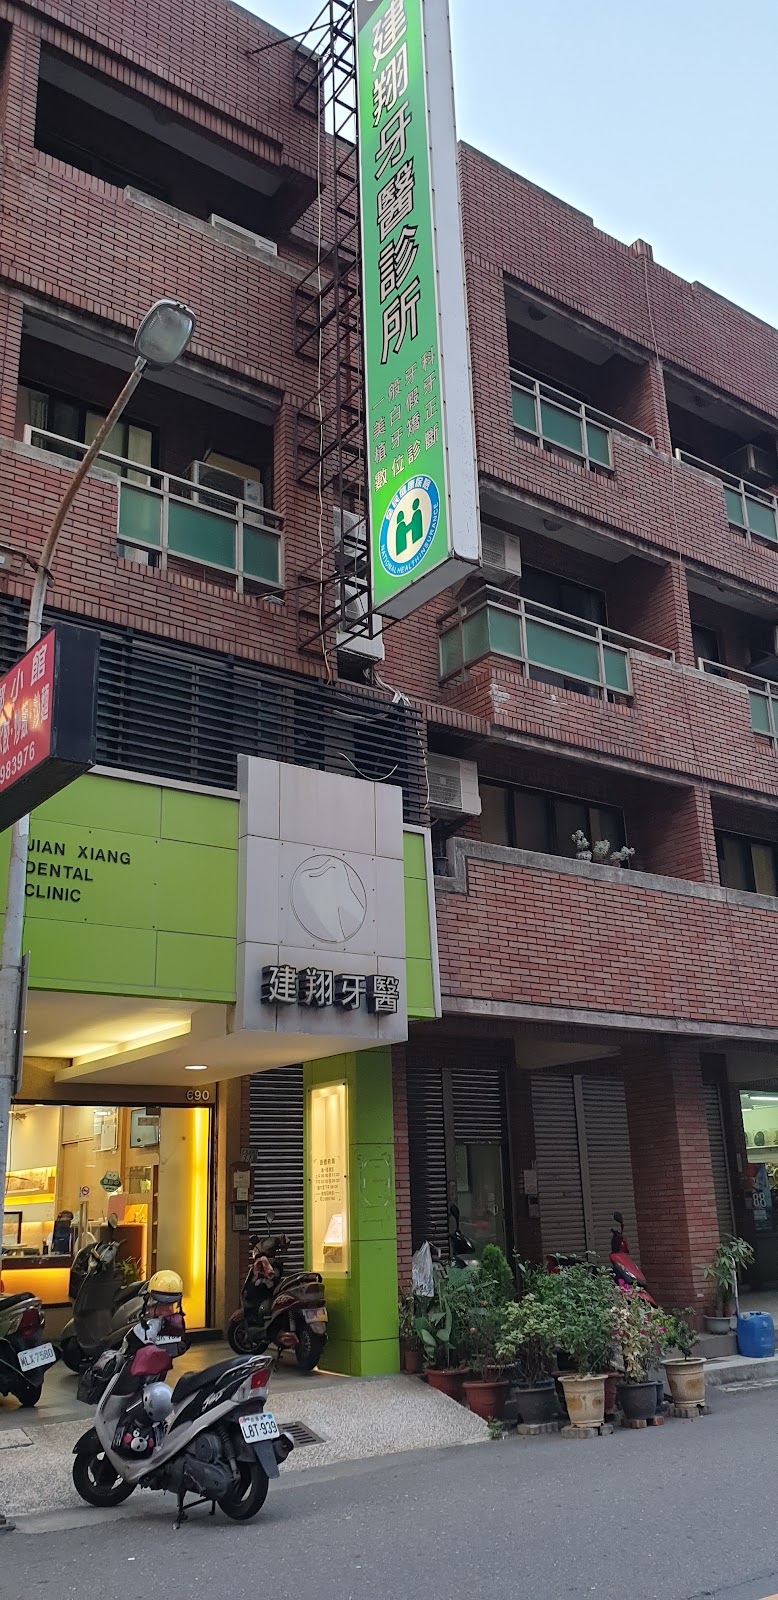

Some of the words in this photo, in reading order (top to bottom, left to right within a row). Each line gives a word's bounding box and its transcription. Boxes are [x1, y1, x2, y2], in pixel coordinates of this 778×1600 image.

[371, 0, 421, 365] 建翔牙醫診所
[372, 345, 435, 411] 一般牙科
[373, 371, 436, 442] 美白假牙
[374, 396, 438, 465] 植牙矯正
[374, 422, 439, 492] 數位診斷
[380, 544, 397, 574] NATIONAL
[397, 557, 419, 574] HEALTH
[418, 501, 438, 558] INSURANCE
[26, 860, 94, 882] DENTAL
[27, 838, 66, 857] JIAN
[77, 844, 131, 865] XIANG
[25, 883, 82, 903] CLINIC
[264, 965, 400, 1013] 建翔牙醫
[186, 1090, 210, 1101] 690
